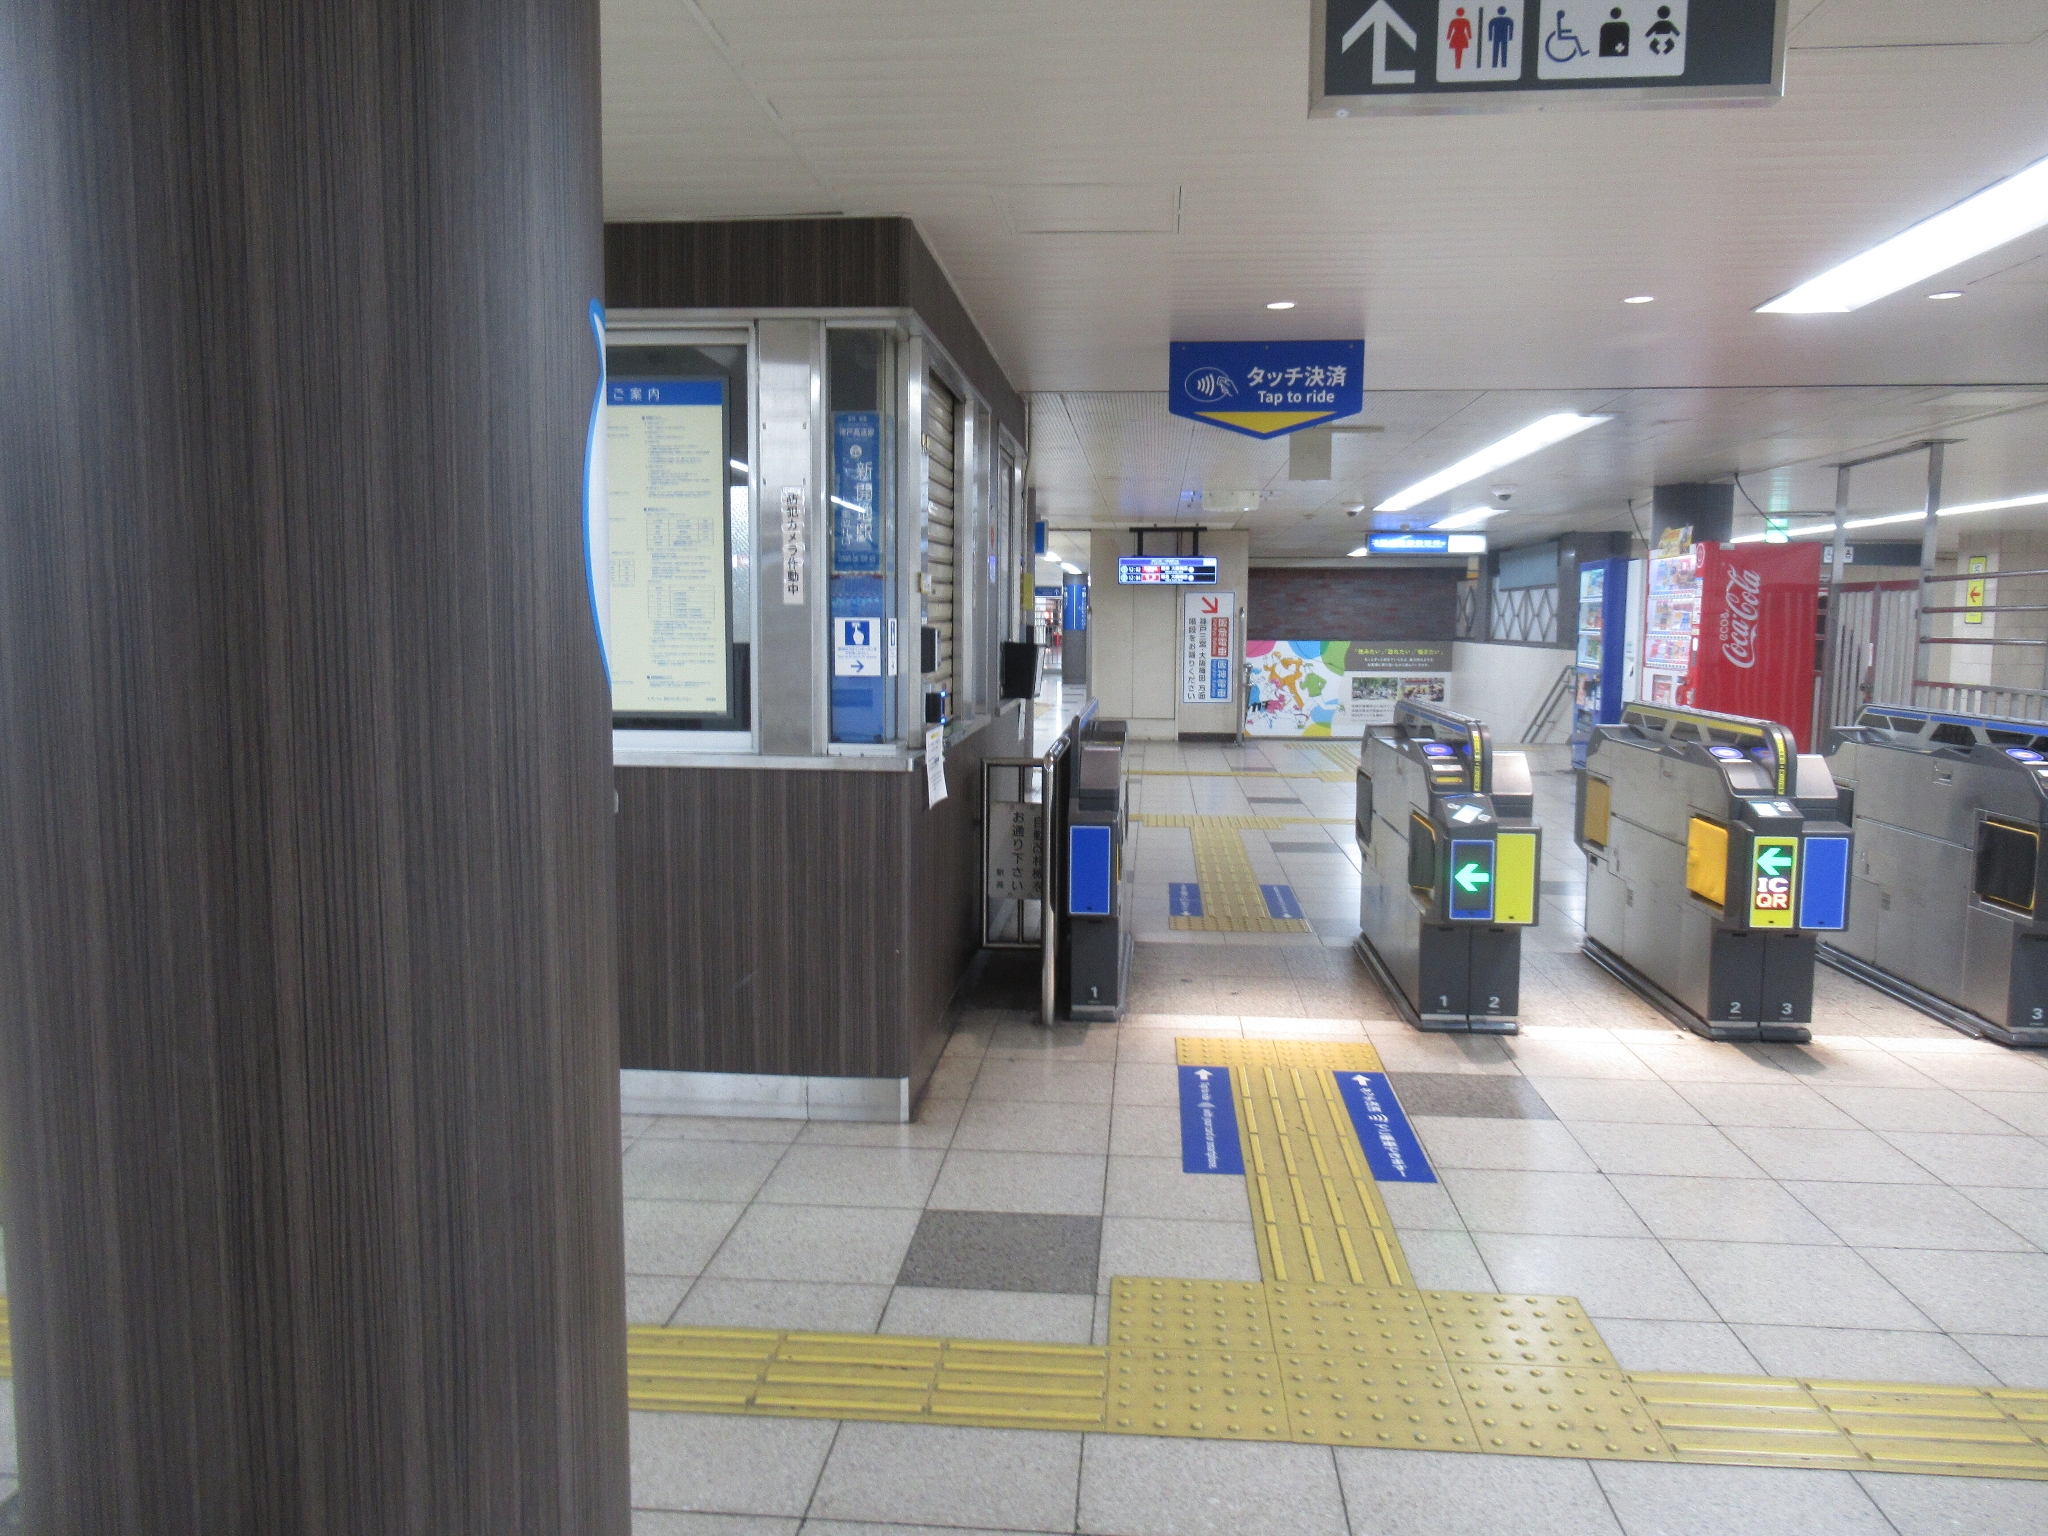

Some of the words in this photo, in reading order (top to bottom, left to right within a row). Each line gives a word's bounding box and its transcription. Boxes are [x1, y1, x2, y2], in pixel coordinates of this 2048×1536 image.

[1247, 365, 1348, 388] タッチ決済
[613, 387, 660, 401] ご案内
[1257, 390, 1283, 406] Tap
[1287, 392, 1302, 403] to
[1306, 389, 1335, 403] ride
[786, 492, 799, 596] 防犯カメラ作動中
[1187, 617, 1197, 699] 階段をお降りください
[1198, 685, 1206, 699] 方面
[1012, 810, 1024, 891] お通り下さい
[1757, 877, 1789, 893] IC
[1756, 893, 1788, 909] QR
[1090, 986, 1098, 998] 1
[1440, 995, 1448, 1007] 1
[1488, 996, 1500, 1008] 2
[1729, 1001, 1741, 1014] 2
[1781, 1002, 1793, 1015] 3
[2032, 1007, 2043, 1020] 3
